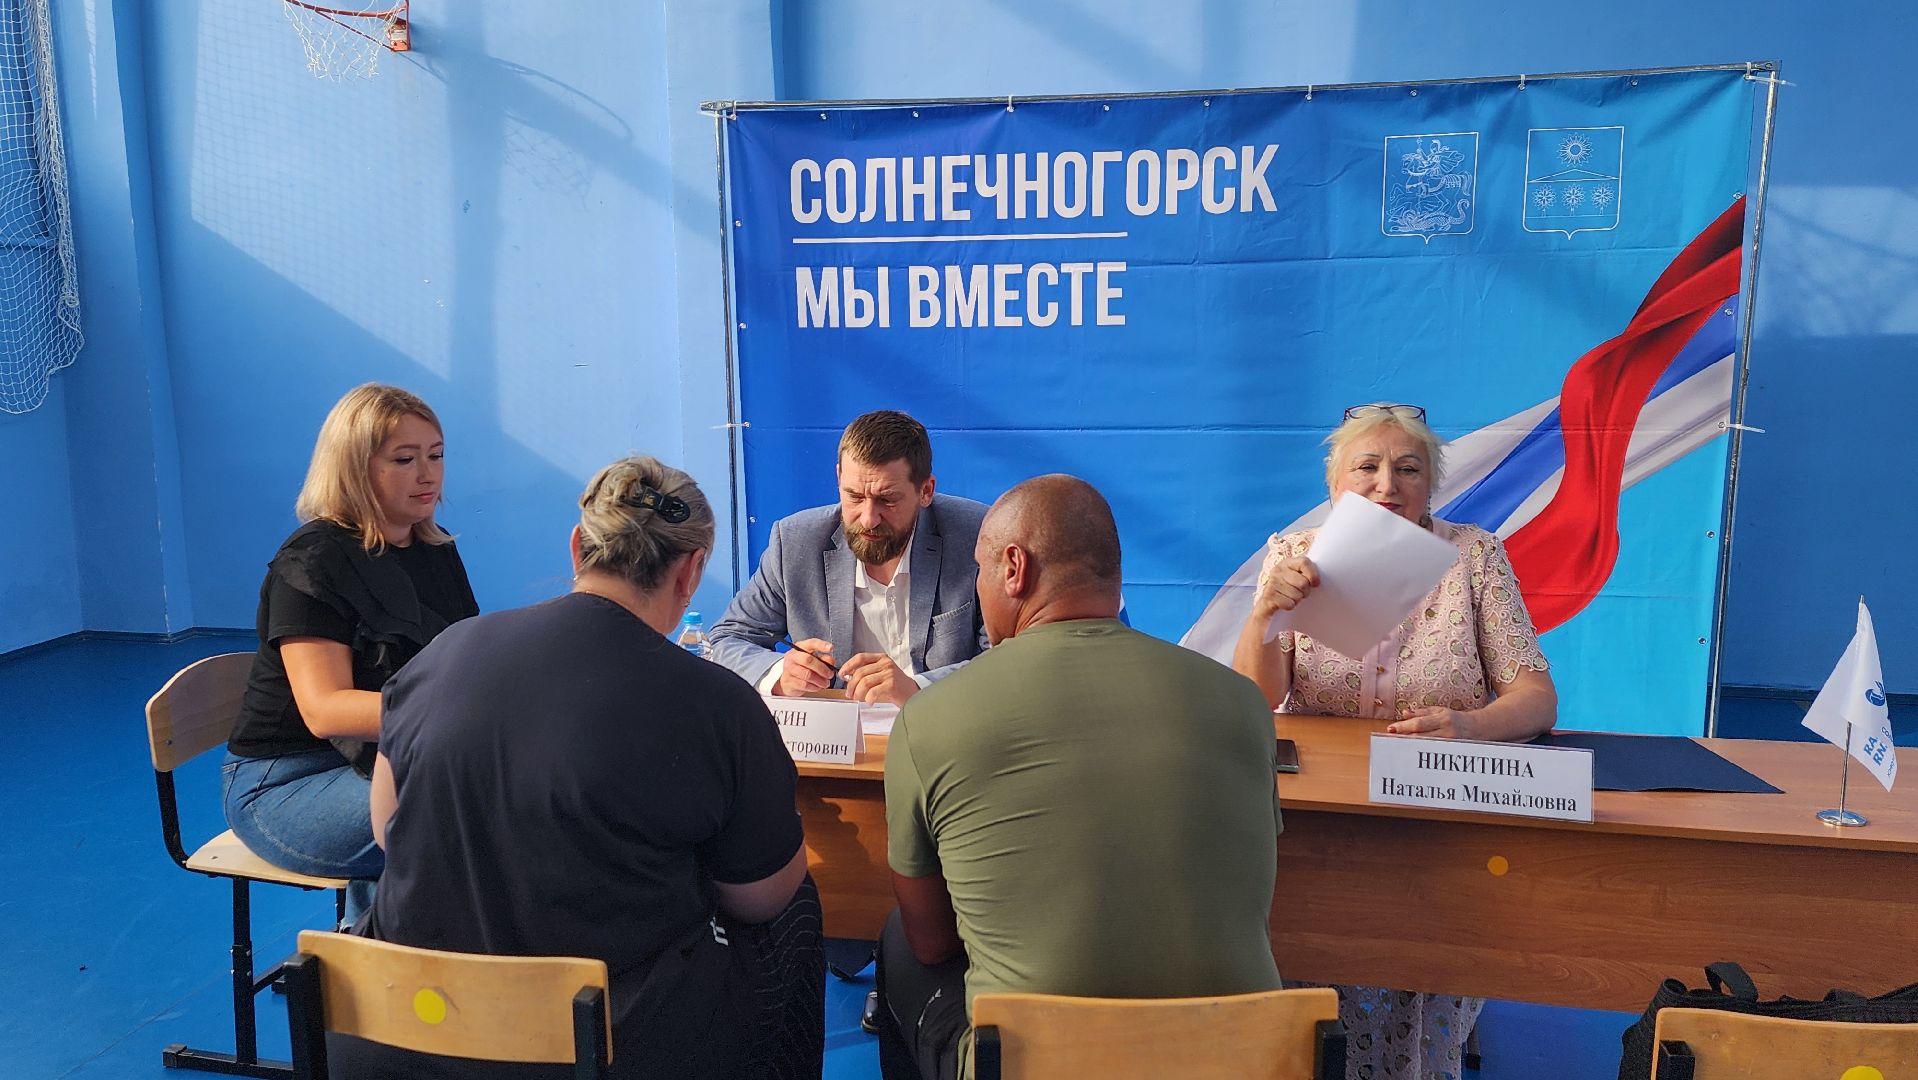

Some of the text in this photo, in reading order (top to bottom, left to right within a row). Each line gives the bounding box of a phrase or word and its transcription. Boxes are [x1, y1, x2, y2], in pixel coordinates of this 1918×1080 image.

[790, 144, 1280, 224] СОЛНЕЧНОГОРСК
[795, 261, 1127, 329] МЫ ВМЕСТЕ
[786, 740, 848, 758] торович
[1417, 751, 1535, 778] НИКИТИНА
[1382, 777, 1577, 812] Наталья Михайловна
